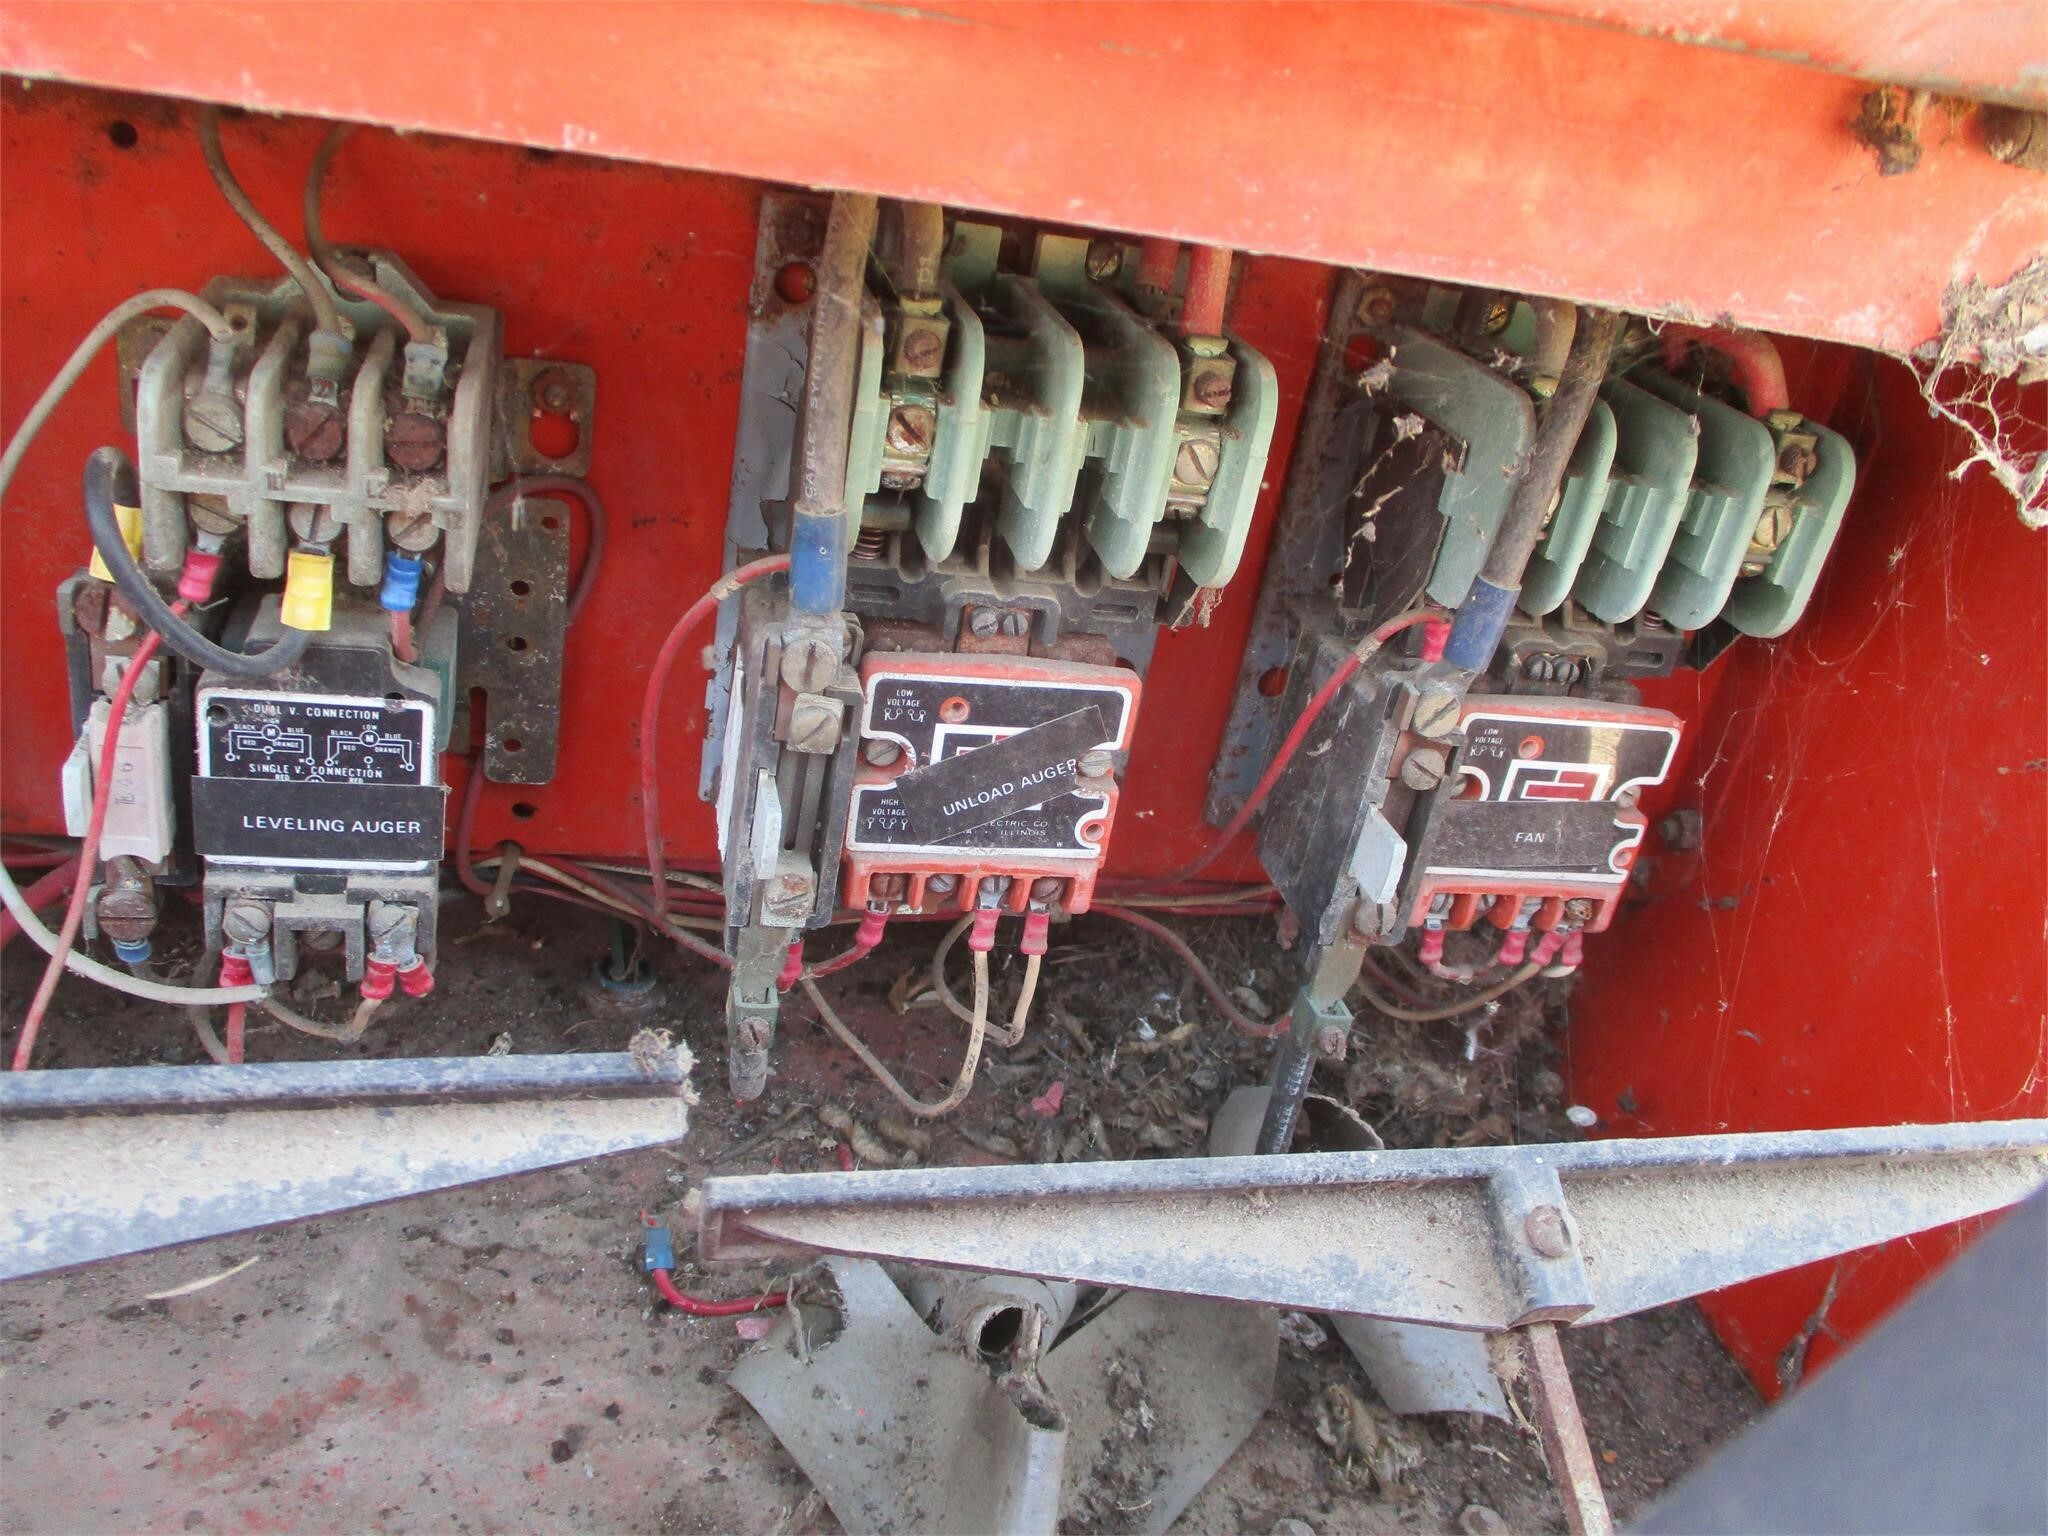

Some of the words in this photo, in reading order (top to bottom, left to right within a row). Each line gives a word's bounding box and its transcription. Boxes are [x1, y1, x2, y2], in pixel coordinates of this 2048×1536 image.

[896, 689, 914, 697] LOW
[886, 698, 921, 707] VOLTAGE
[254, 703, 282, 715] DUAL
[306, 707, 380, 720] CONNECTION
[233, 723, 256, 731] BLACK
[267, 728, 275, 737] M
[330, 729, 353, 737] BLACK
[365, 734, 375, 743] M
[1475, 736, 1503, 744] VOLTAGE
[272, 740, 299, 748] ORANGE
[249, 763, 290, 774] SINGLE
[311, 766, 383, 779] CONNECTION
[942, 782, 1014, 816] UNLOAD
[1021, 758, 1077, 789] AUGER
[880, 798, 899, 806] HIGH
[872, 808, 907, 816] VOLTAGE
[242, 815, 345, 833] LEVELING
[351, 820, 422, 834] AUGER
[1515, 832, 1545, 843] FAN
